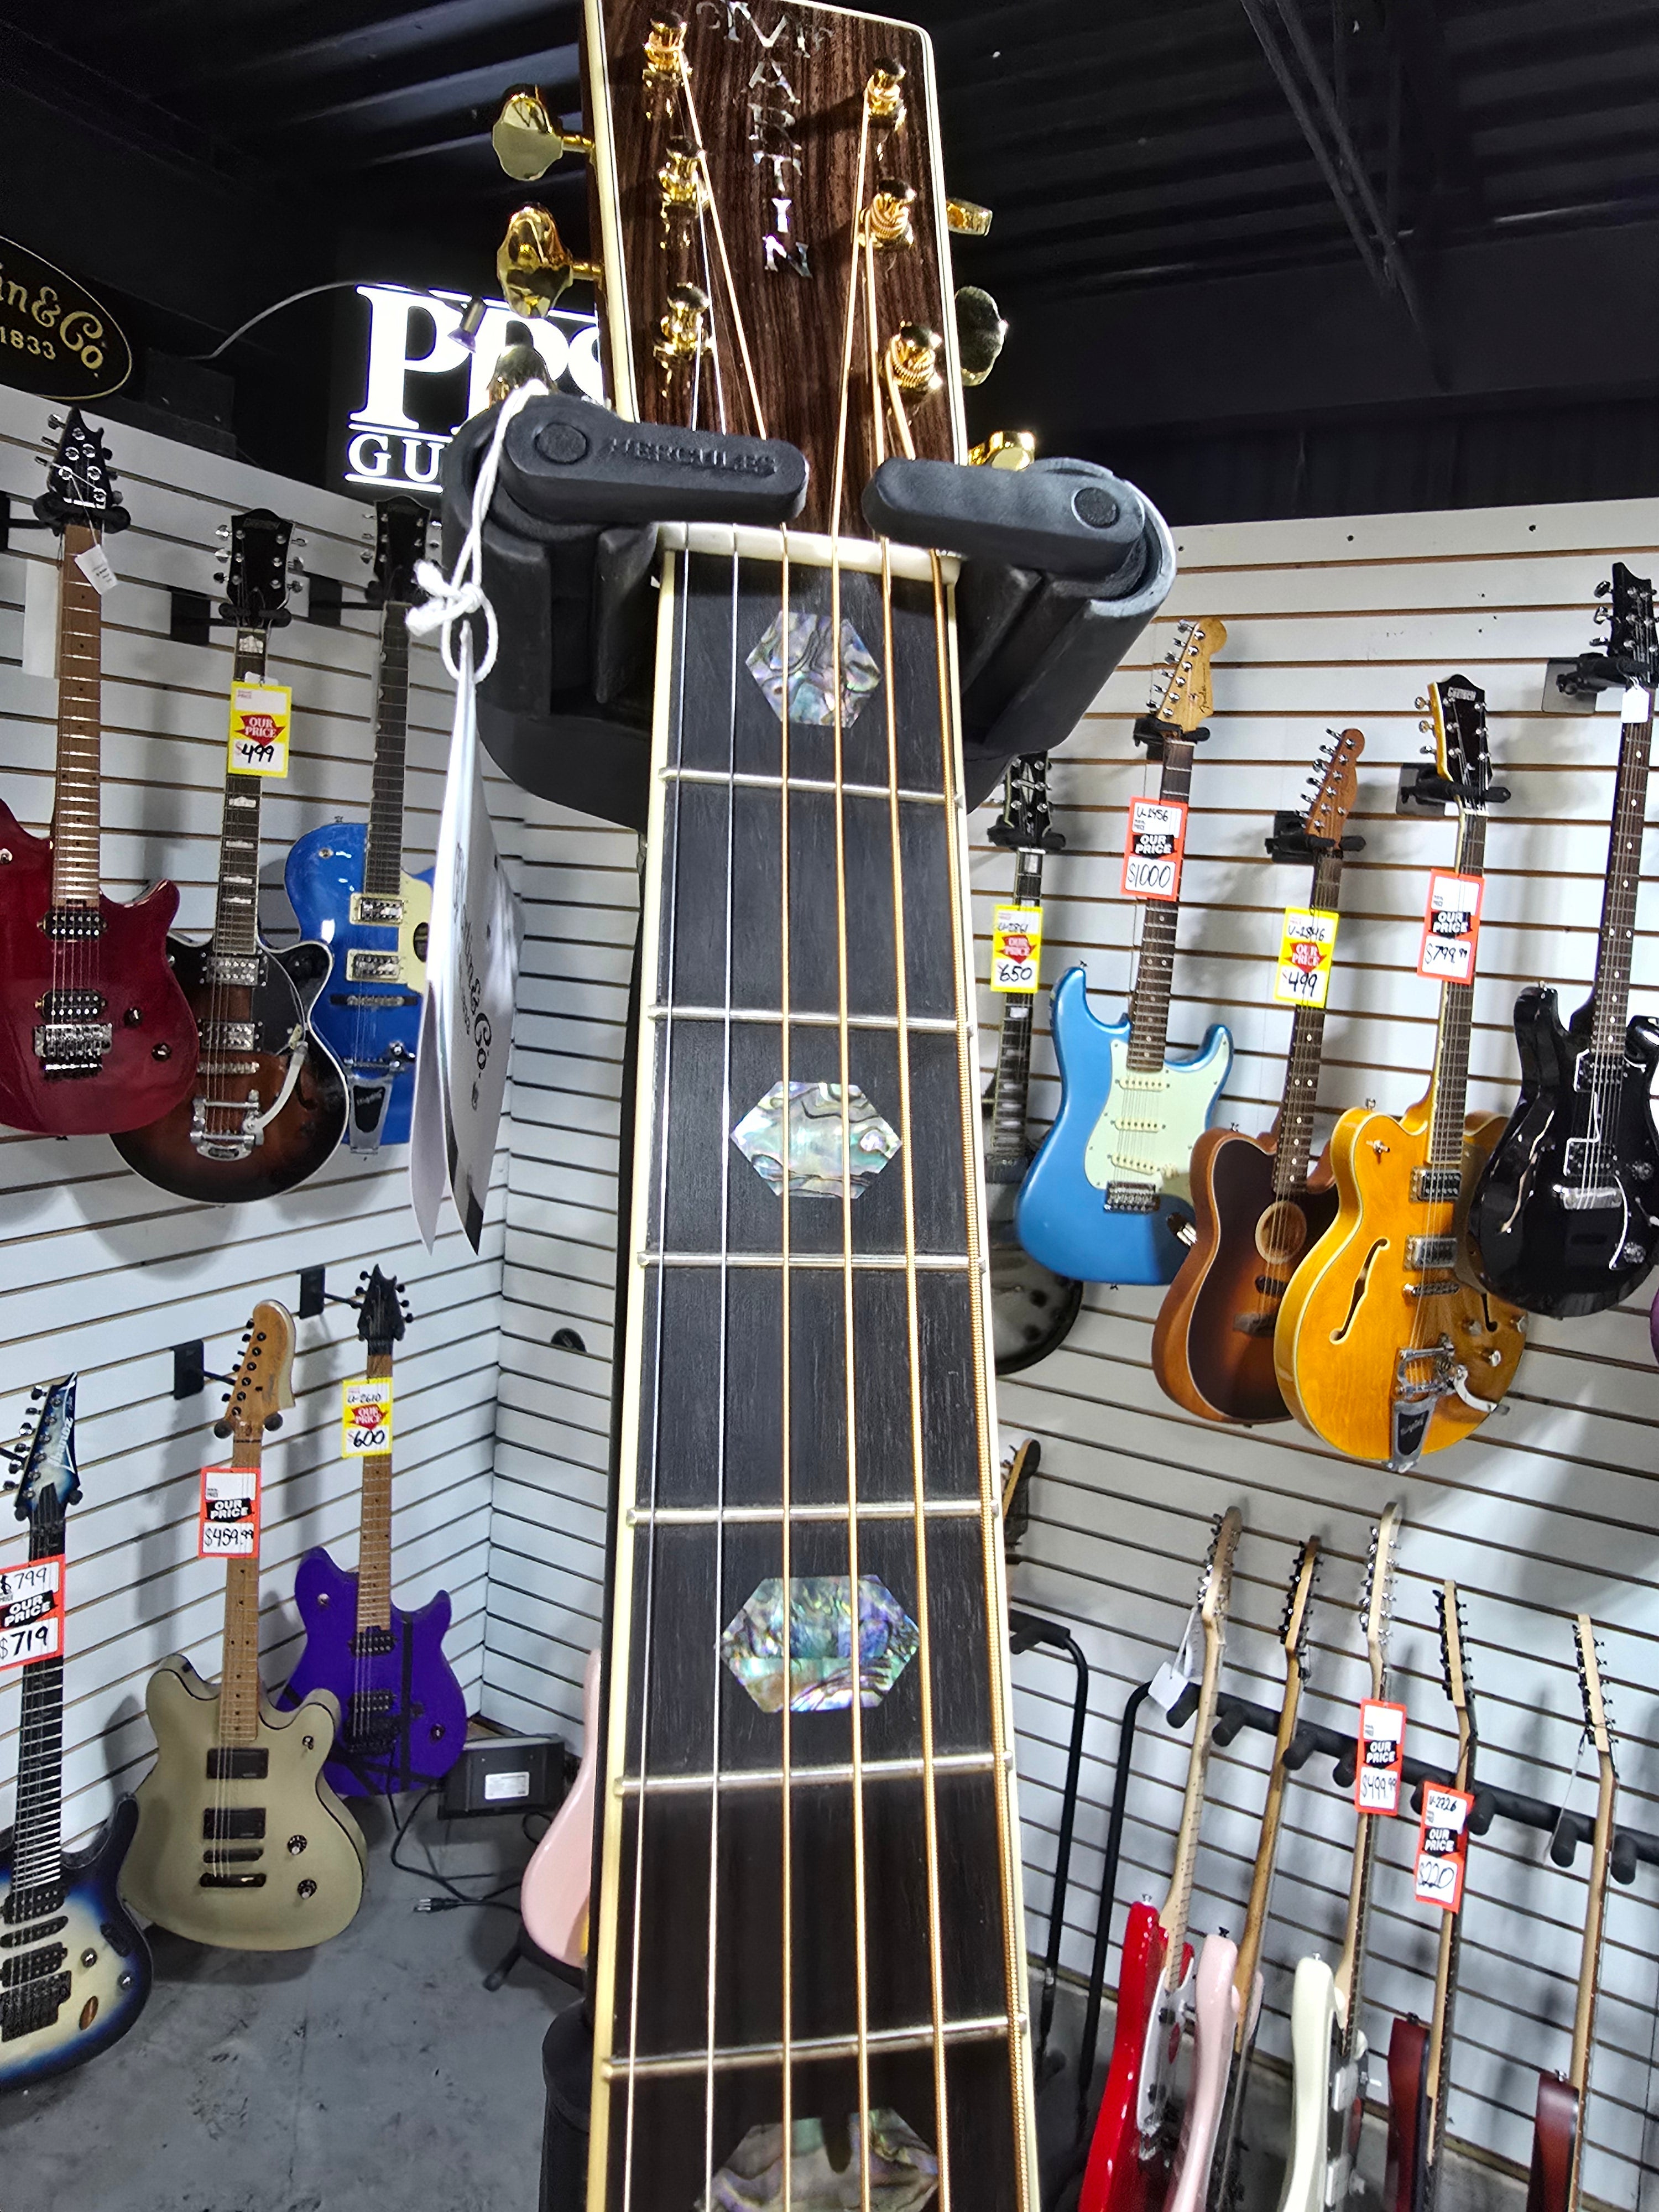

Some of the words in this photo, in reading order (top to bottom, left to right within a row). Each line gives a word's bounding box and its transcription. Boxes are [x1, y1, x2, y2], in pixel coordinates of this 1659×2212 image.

[0, 326, 56, 360] 1833
[249, 717, 273, 728] OUR
[244, 727, 276, 738] PRICE
[1140, 834, 1167, 845] OUR
[1135, 844, 1172, 855] PRICE
[1128, 863, 1171, 888] $1000
[1437, 912, 1464, 923] OUR
[1432, 921, 1469, 933] PRICE
[1296, 944, 1318, 956] OUR
[1291, 953, 1320, 967] PRICE
[357, 1406, 379, 1417] OUR
[355, 1413, 382, 1424] PRICE
[214, 1499, 242, 1511] OUR
[210, 1506, 248, 1520] PRICE
[9, 1594, 44, 1615] OUR
[4, 1601, 51, 1627] PRICE
[0, 1626, 48, 1660] $719
[1369, 1742, 1391, 1752] OUR
[1366, 1751, 1396, 1764] PRICE
[1428, 1828, 1450, 1839] OUR
[1425, 1838, 1455, 1852] PRICE
[1418, 1861, 1454, 1889] $220
